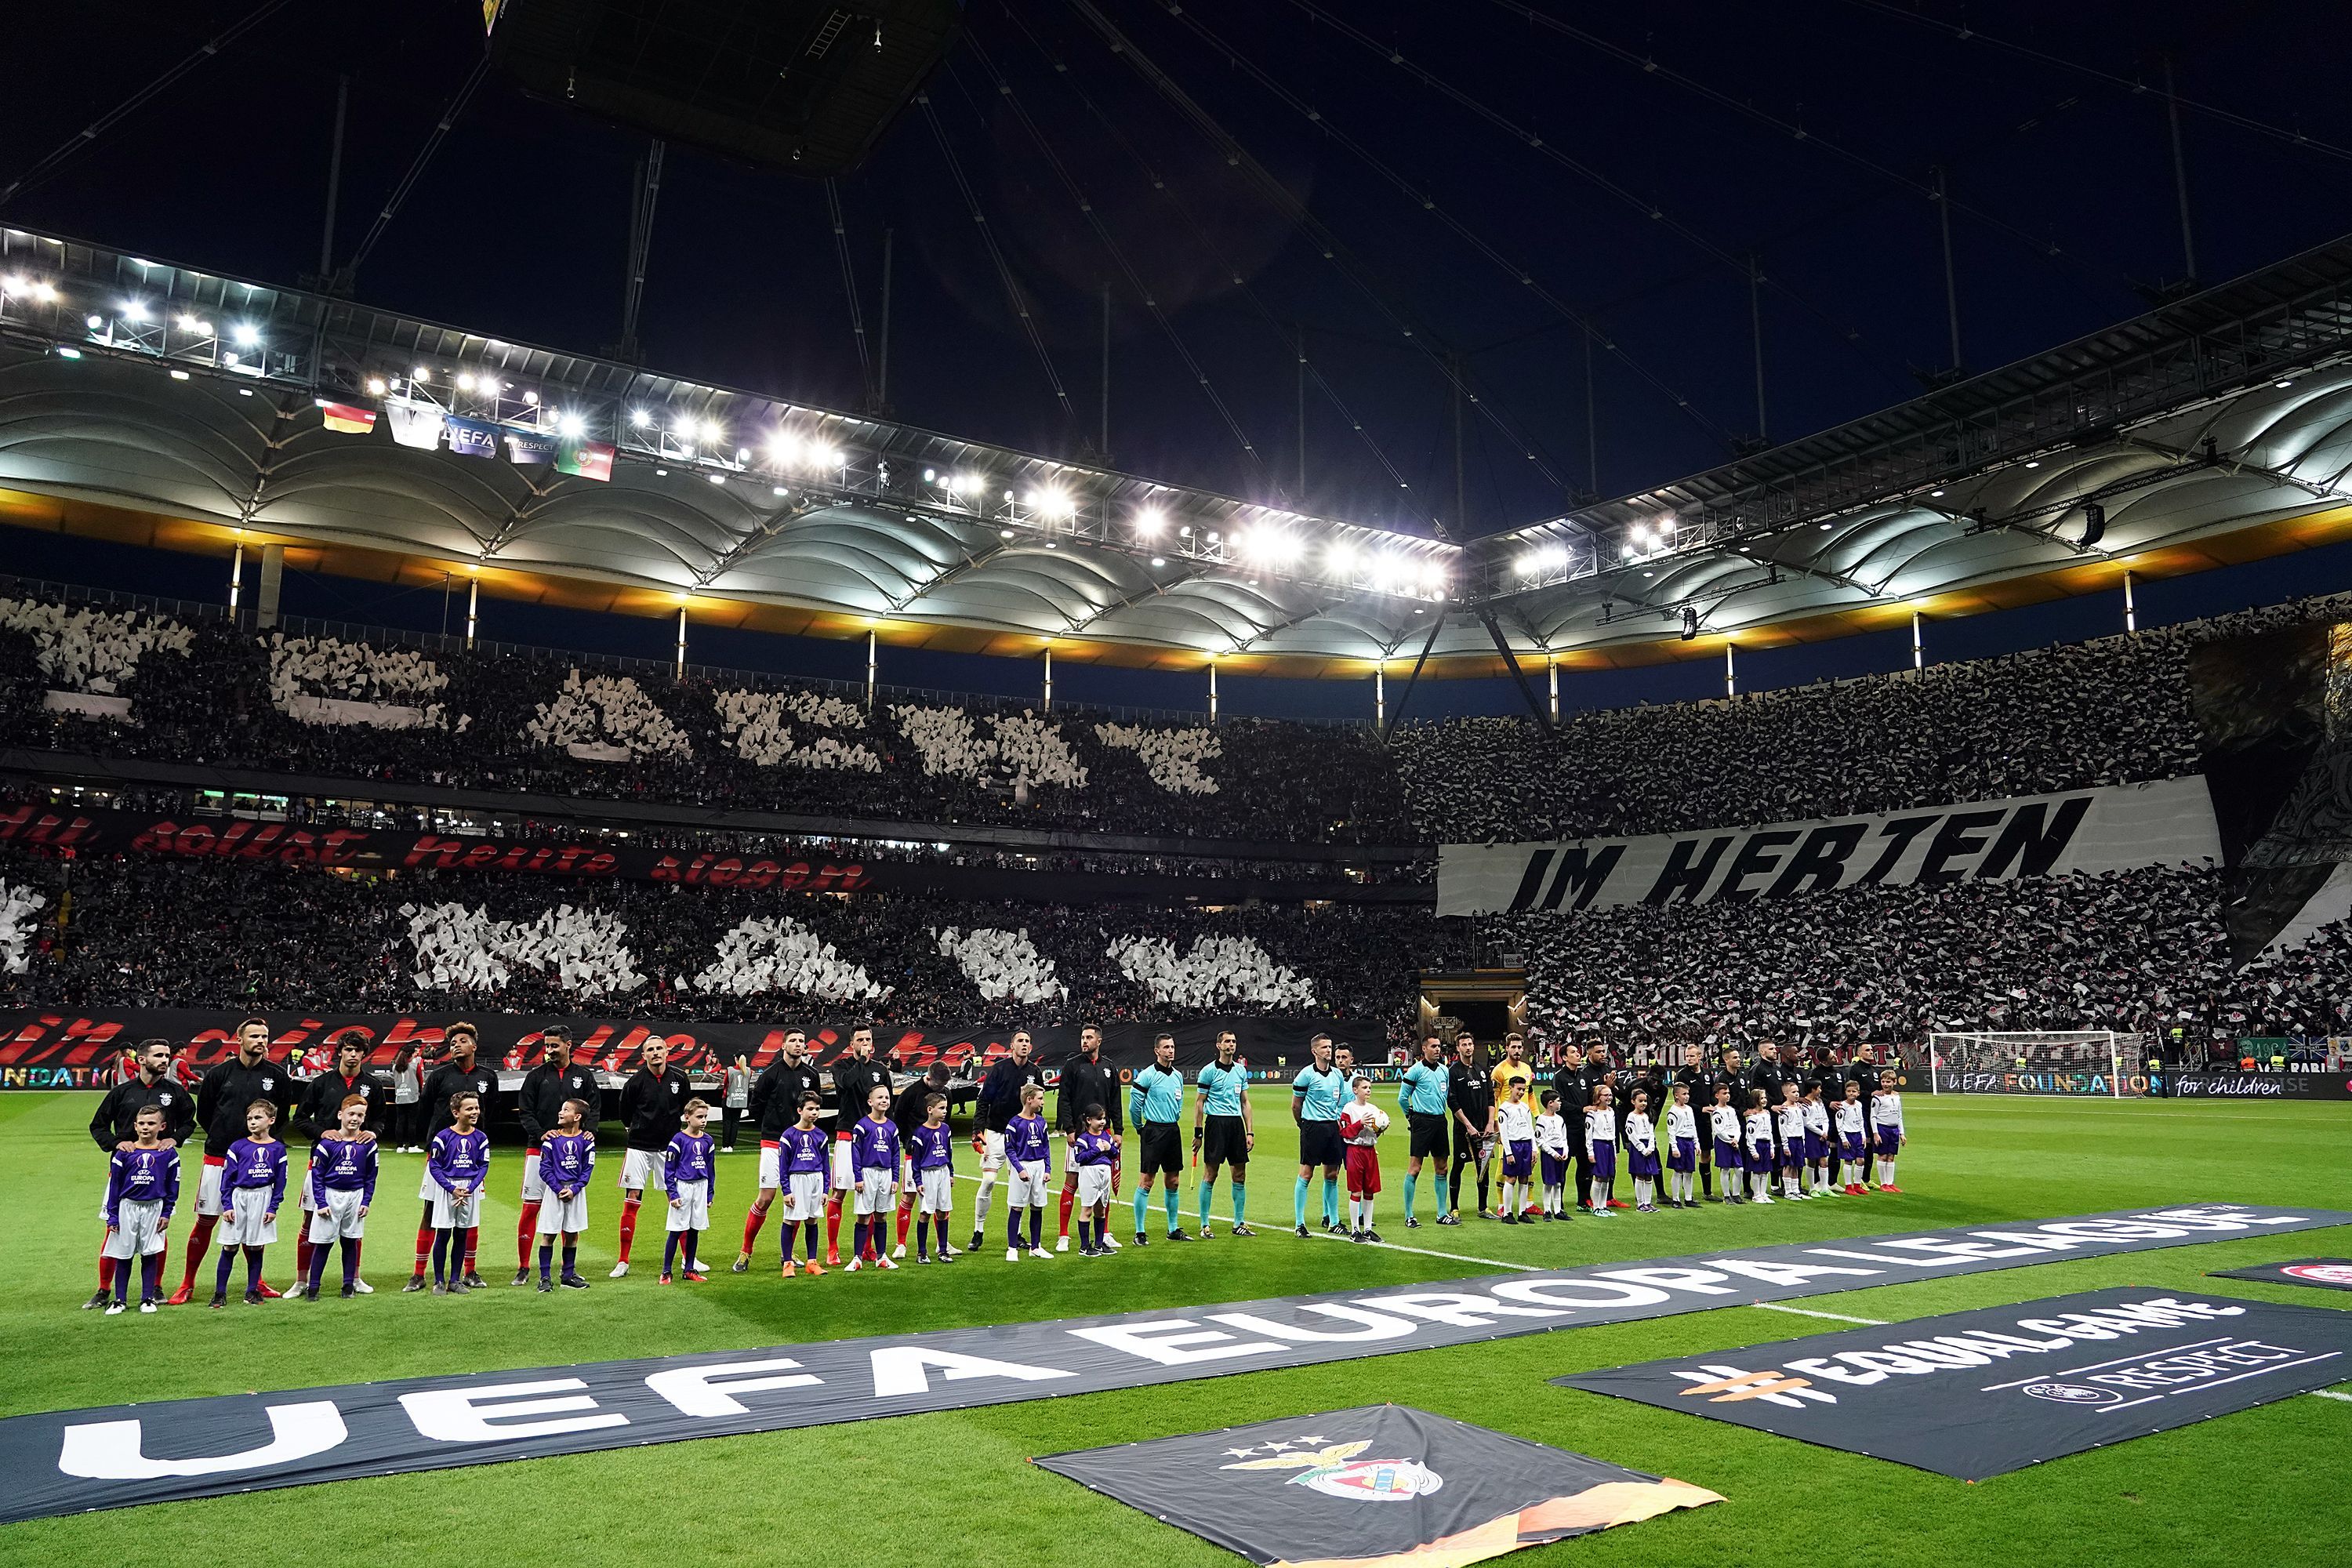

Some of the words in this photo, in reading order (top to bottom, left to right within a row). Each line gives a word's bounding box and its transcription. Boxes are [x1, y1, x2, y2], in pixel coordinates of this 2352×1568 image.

[517, 441, 554, 451] RESPECT
[131, 820, 370, 866] sollst
[403, 836, 619, 873] heute
[650, 853, 877, 891] siegen
[1508, 844, 1628, 913] IM
[1949, 1073, 1998, 1091] UEFA
[2004, 1072, 2169, 1094] FOUNDATION
[2175, 1074, 2204, 1097] for
[2208, 1075, 2281, 1096] children
[57, 1346, 1080, 1481] UEFA
[1064, 1258, 1886, 1366] EUROPA
[1802, 1208, 2311, 1267] LEAGUE
[1669, 1297, 2246, 1409] #EQUALGAME
[2101, 1340, 2306, 1390] RESPECT
